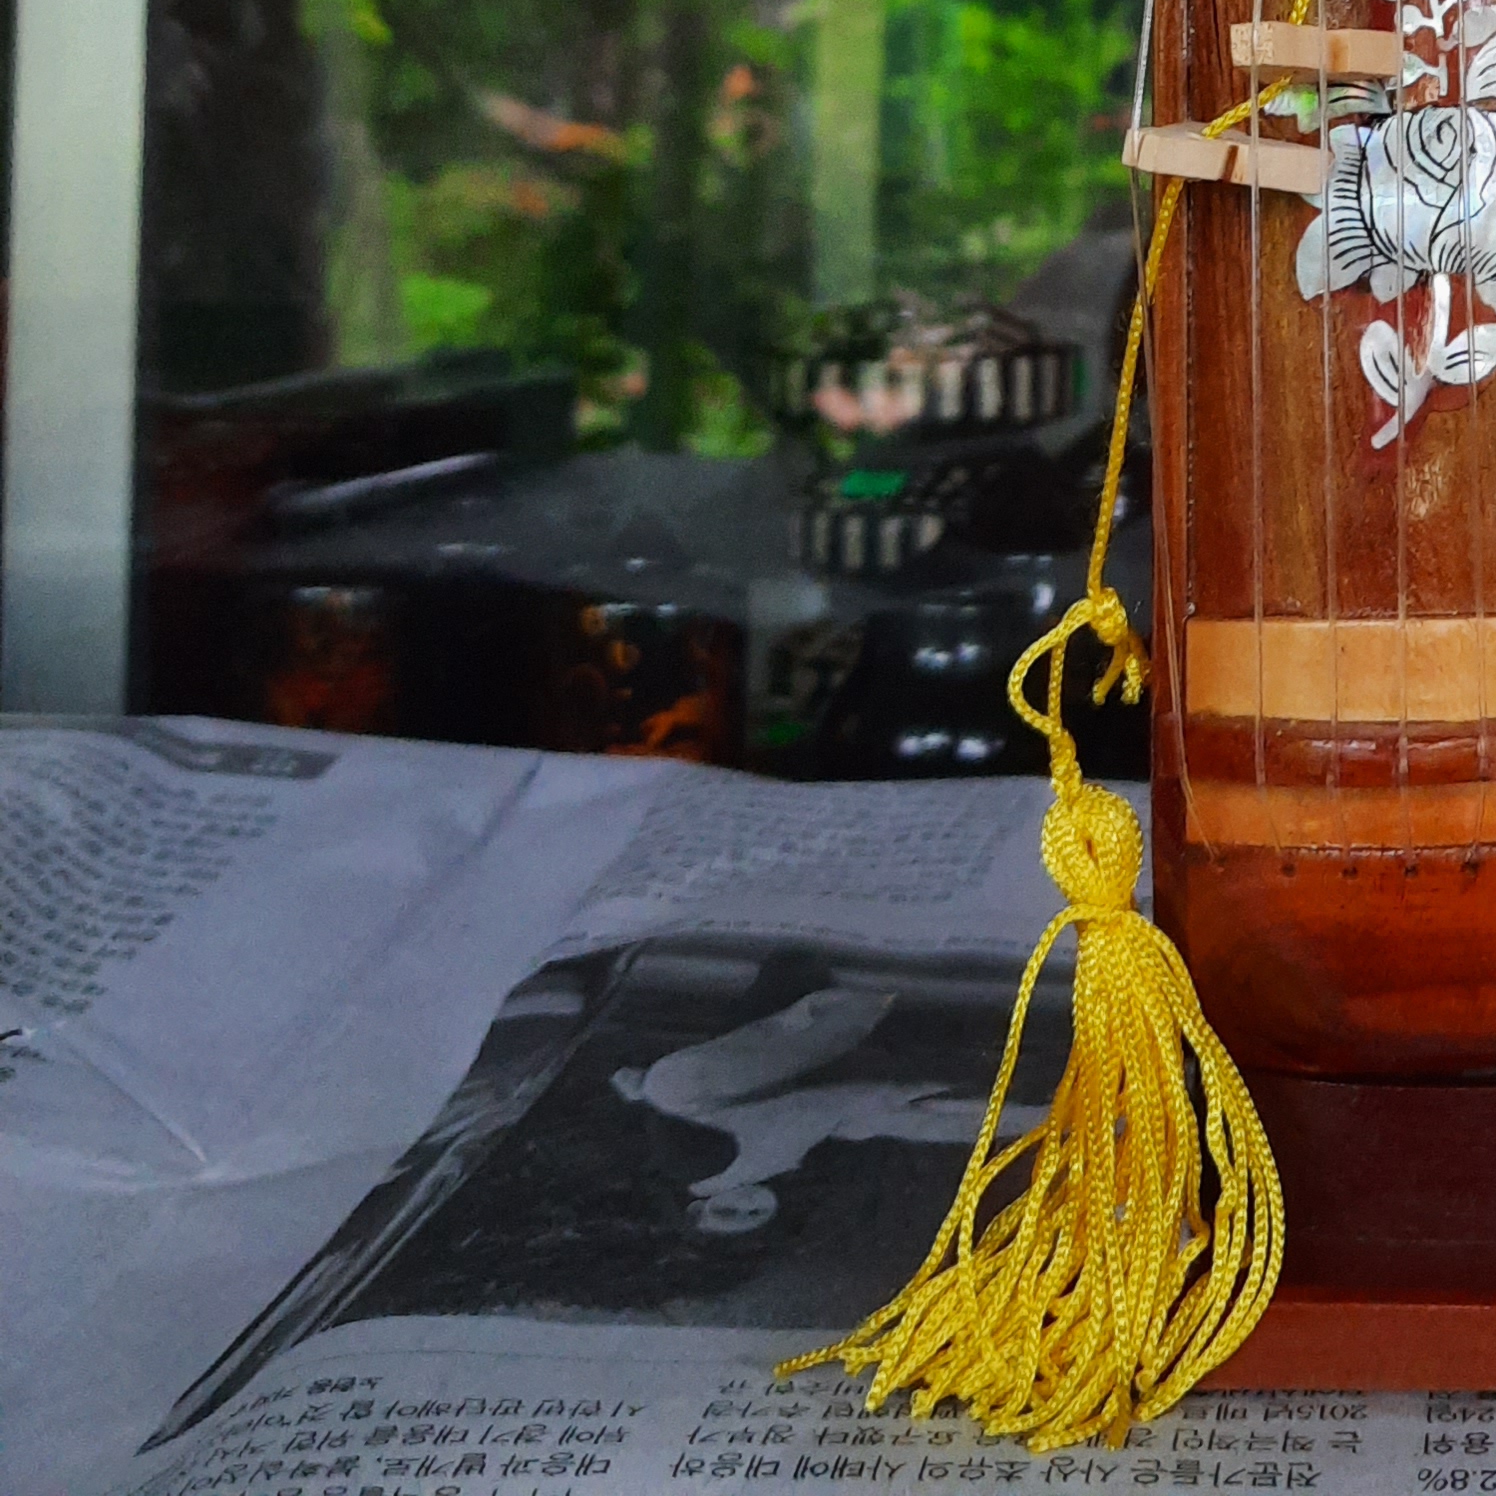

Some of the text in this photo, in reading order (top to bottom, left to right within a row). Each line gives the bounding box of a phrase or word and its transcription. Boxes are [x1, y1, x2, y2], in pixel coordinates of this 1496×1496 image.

[337, 1399, 377, 1420] 할
[381, 1398, 524, 1421] 판단해야
[610, 1399, 646, 1418] 시
[1263, 1403, 1368, 1419] 2015년
[1424, 1406, 1495, 1423] 24일
[281, 1428, 354, 1454] 위한
[362, 1423, 470, 1446] 대응을
[478, 1423, 549, 1445] 경기
[557, 1424, 631, 1444] 뒤에
[686, 1424, 793, 1445] 정부가
[812, 1425, 960, 1445] 요구했다.
[1170, 1428, 1315, 1453] 적극적인
[1326, 1433, 1363, 1453] 는
[376, 1453, 489, 1479] 별개로,
[499, 1452, 610, 1477] 대응과
[668, 1451, 1321, 1488] 전문가들은 사상 초유의 사태에 대응하
